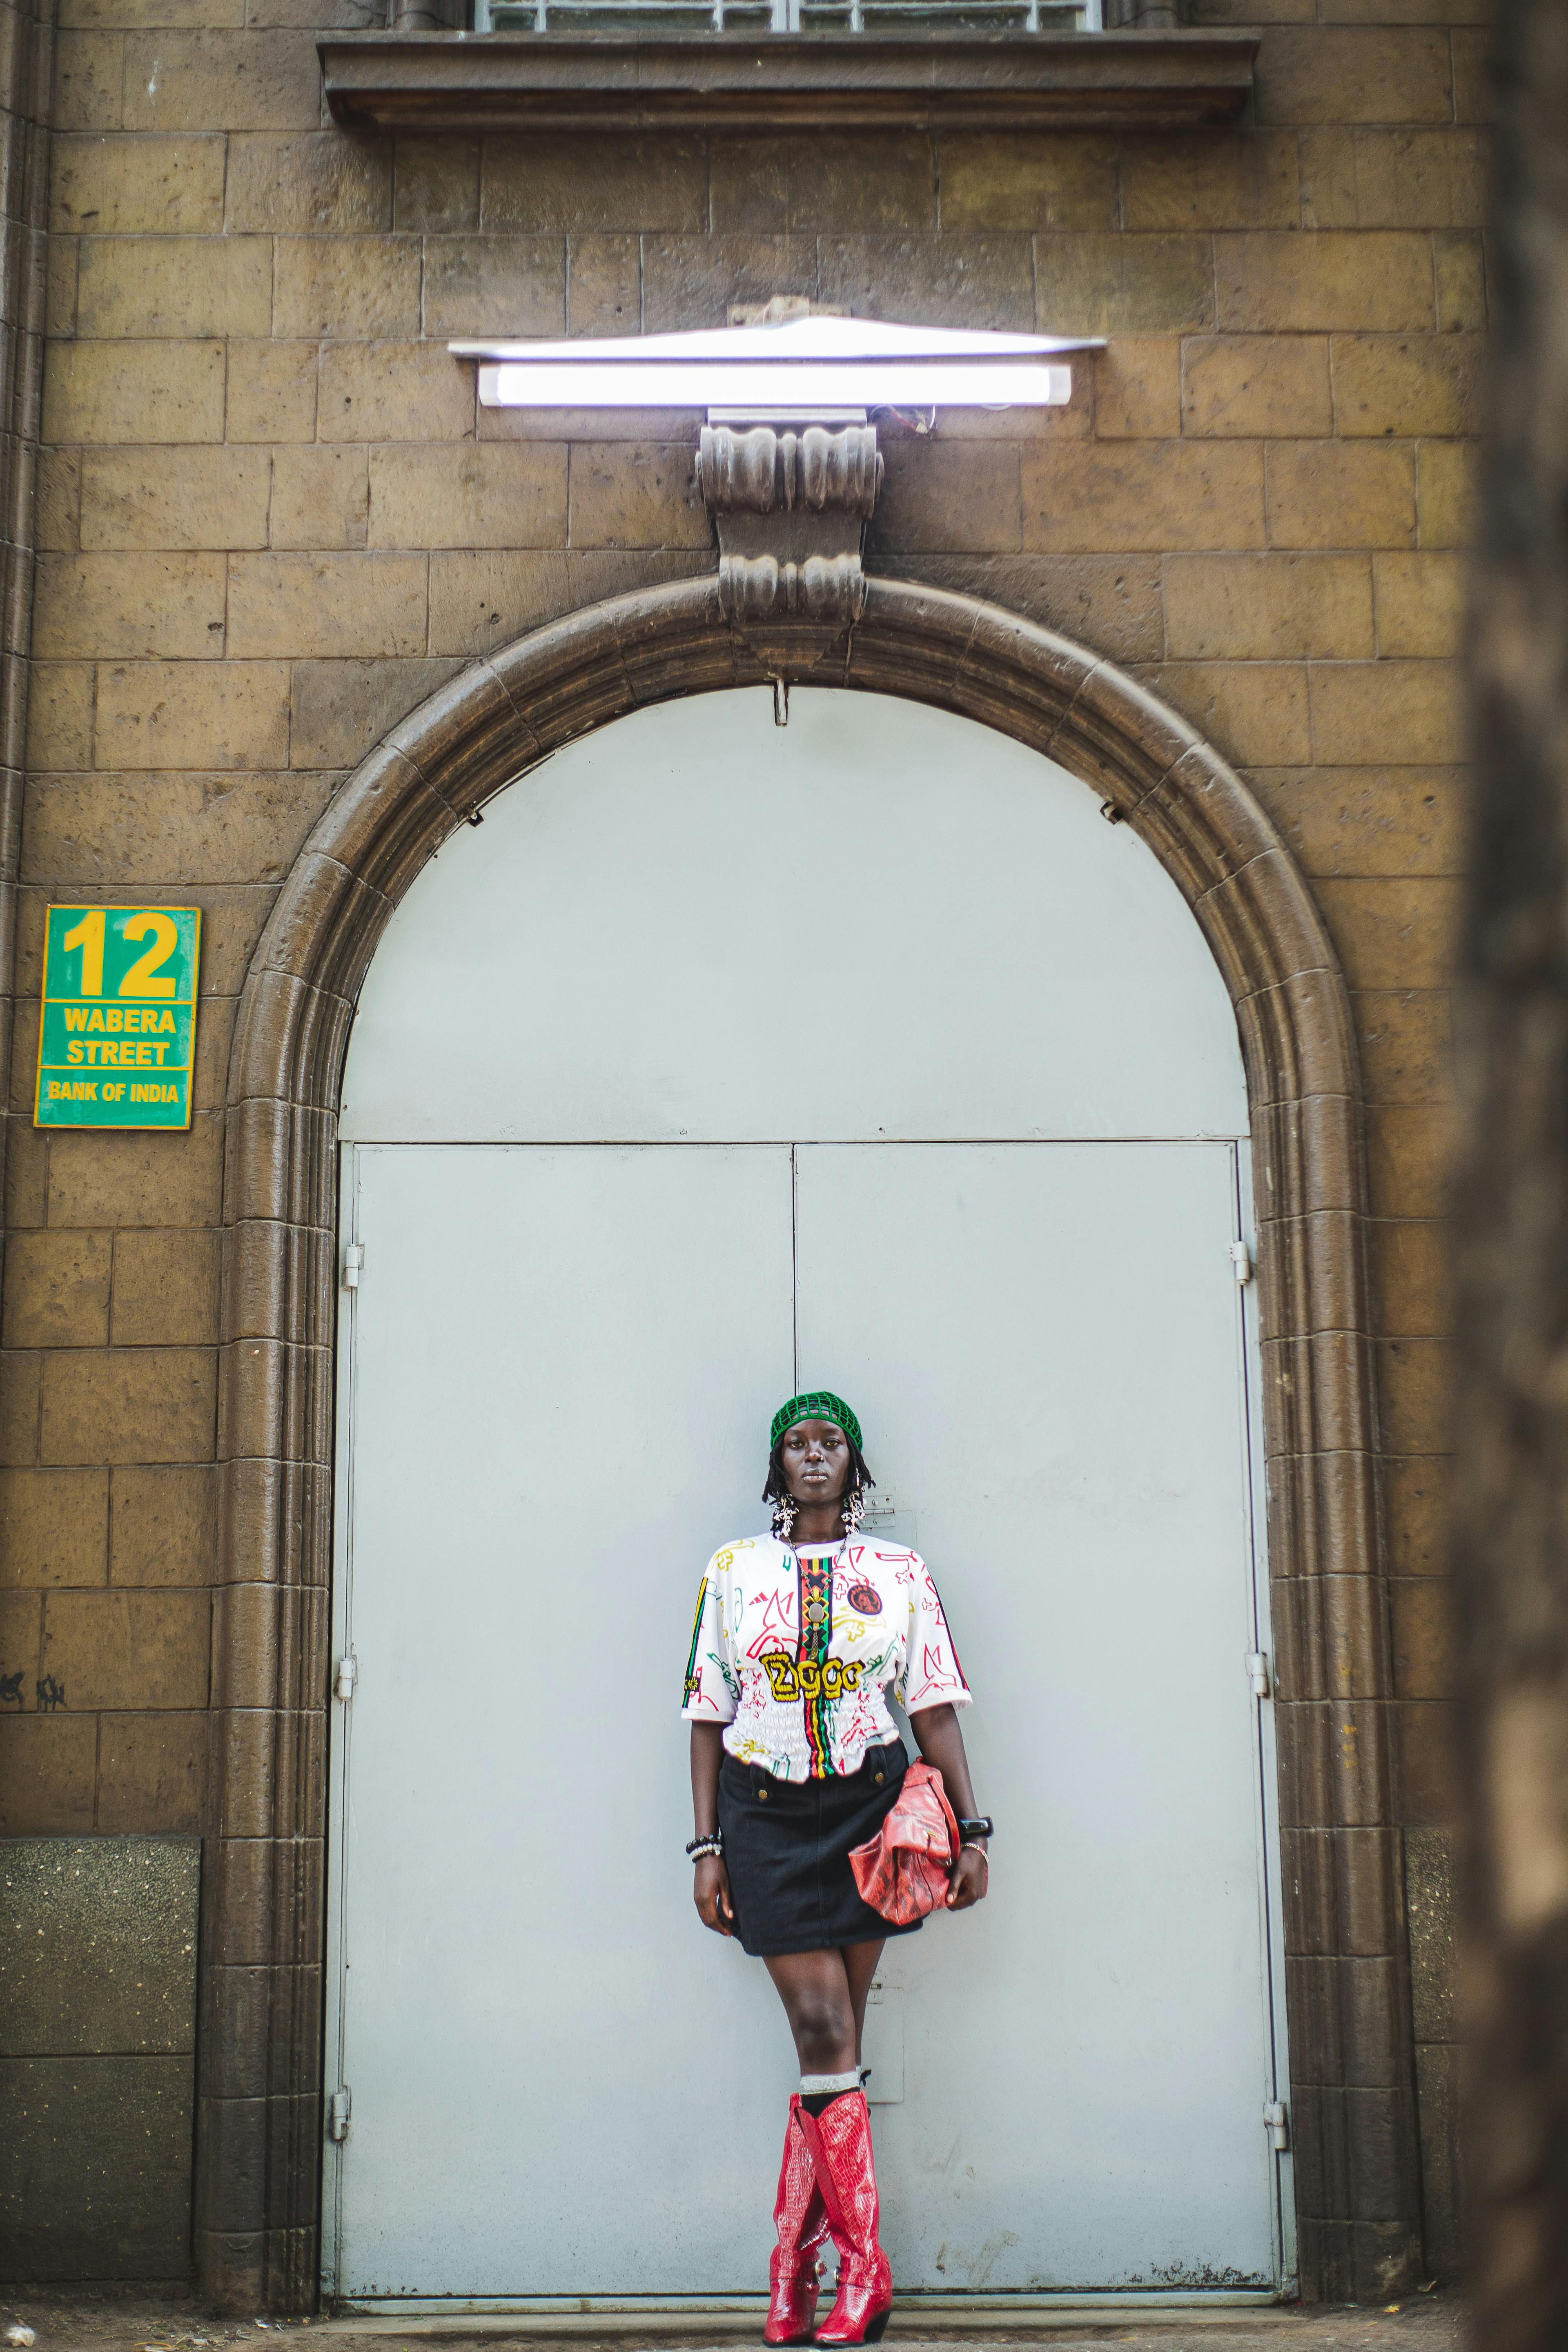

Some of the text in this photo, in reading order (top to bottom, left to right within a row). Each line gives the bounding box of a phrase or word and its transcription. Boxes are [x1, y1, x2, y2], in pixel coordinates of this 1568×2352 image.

[65, 911, 178, 997] 12
[65, 1008, 176, 1033] WABERA
[67, 1040, 170, 1065] STREET
[49, 1081, 179, 1102] BANK OF INDIA
